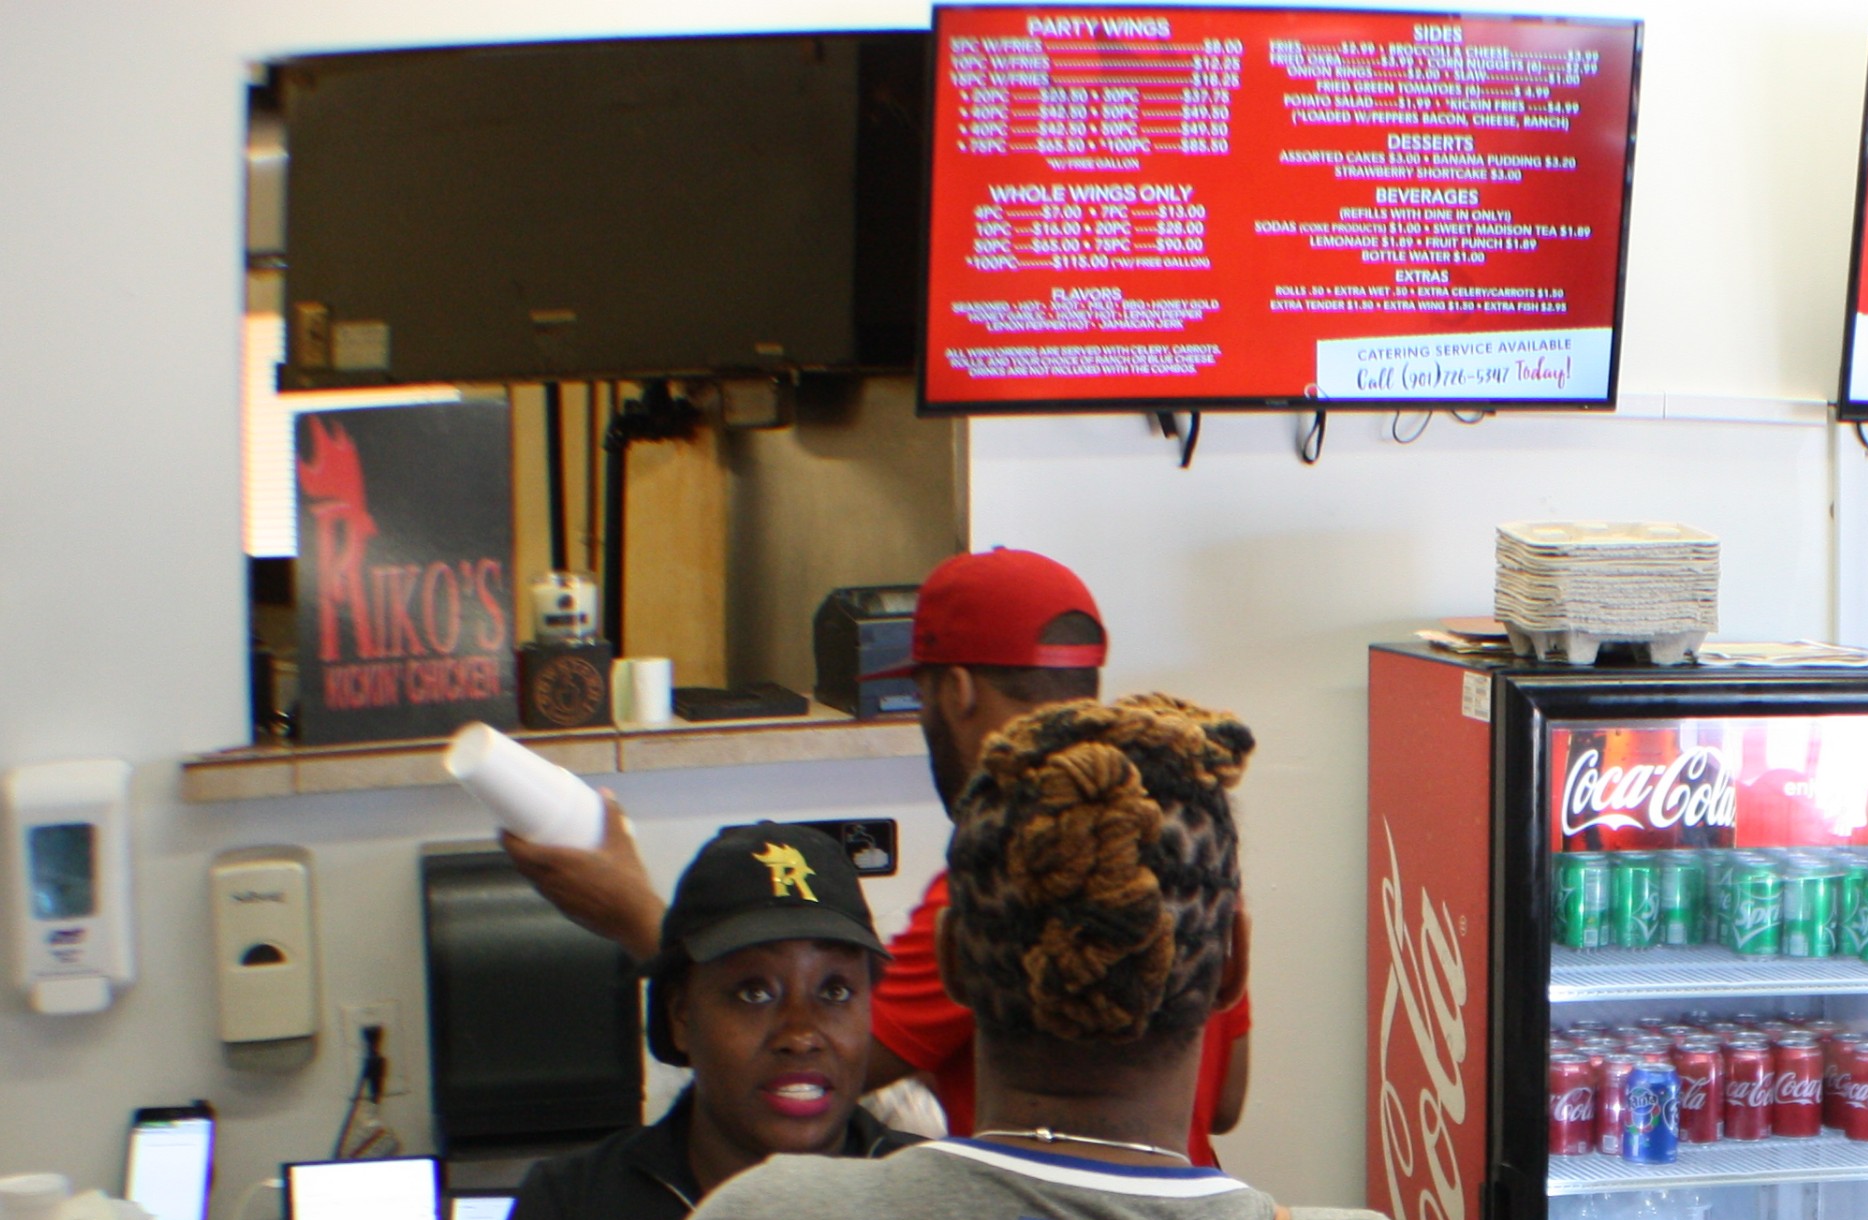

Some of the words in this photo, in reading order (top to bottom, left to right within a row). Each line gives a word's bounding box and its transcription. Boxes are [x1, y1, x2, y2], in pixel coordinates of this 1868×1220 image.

[1027, 16, 1098, 37] PARTY
[1101, 17, 1170, 39] WINGS
[1414, 24, 1462, 43] SIDES
[1287, 66, 1333, 79] ONION
[1454, 70, 1487, 83] SLAW
[1317, 80, 1351, 95] FRIED
[1354, 81, 1394, 96] GREEN
[1398, 82, 1462, 97] TOMATOES
[1283, 94, 1331, 109] POTATO
[1335, 95, 1374, 110] SALAD
[1494, 99, 1525, 113] FRIES
[1422, 113, 1469, 128] BACON,
[1472, 114, 1520, 129] CHEESE,
[1524, 116, 1570, 130] RANCH)
[1388, 134, 1474, 152] DESSERTS
[1279, 150, 1343, 165] ASSORTED
[1346, 152, 1386, 166] CAKES
[1433, 154, 1485, 168] BANANA
[1488, 155, 1542, 169] PUDDING
[1334, 166, 1413, 180] STRAWBERRY
[1417, 167, 1487, 182] SHORTCAKE
[1490, 169, 1522, 182] $3.00
[989, 184, 1065, 203] WHOLE
[1069, 184, 1136, 203] WINGS
[1140, 184, 1194, 203] ONLY
[1376, 187, 1479, 205] BEVERAGES
[1041, 205, 1082, 221] $7.00
[1157, 204, 1206, 220] $13.00
[1339, 208, 1388, 221] (REFILLS
[1391, 208, 1421, 222] WITH
[1424, 209, 1453, 222] DINE
[1032, 221, 1081, 236] $16.00
[1254, 221, 1296, 234] SODAS
[1388, 223, 1421, 236] $1.00
[1433, 223, 1472, 236] SWEET
[1475, 224, 1532, 237] MADISON
[1534, 224, 1557, 237] TEA
[1155, 237, 1204, 253] $90.00
[1310, 236, 1379, 249] LEMONADE
[1425, 237, 1458, 250] FRUIT
[1461, 238, 1502, 251] PUNCH
[1505, 238, 1537, 251] $1.89
[1362, 250, 1406, 264] BOTTLE
[1409, 251, 1450, 264] WATER
[1453, 251, 1485, 264] $1.00
[1395, 270, 1449, 285] EXTRAS
[1052, 287, 1122, 301] FLAVORS
[1275, 286, 1306, 297] ROLLS
[1334, 287, 1366, 298] EXTRA
[1369, 287, 1389, 298] WET
[1417, 287, 1449, 299] EXTRA
[1451, 288, 1535, 299] CELERY/CARROTS
[1270, 299, 1302, 311] EXTRA
[1306, 300, 1345, 311] TENDER
[1383, 300, 1416, 311] EXTRA
[1419, 301, 1446, 312] WING
[1484, 301, 1515, 312] EXTRA
[1518, 302, 1539, 312] FISH
[1358, 346, 1430, 362] CATERING
[1436, 343, 1492, 357] SERVICE
[1497, 339, 1572, 354] AVAILABLE
[1357, 369, 1394, 391] Call
[1515, 355, 1572, 389] Today!
[308, 485, 506, 662] RIKO'S
[404, 655, 500, 704] CHICKEN
[1561, 746, 1737, 837] Coca-Cola
[760, 853, 819, 902] R
[1734, 900, 1780, 928] Spri
